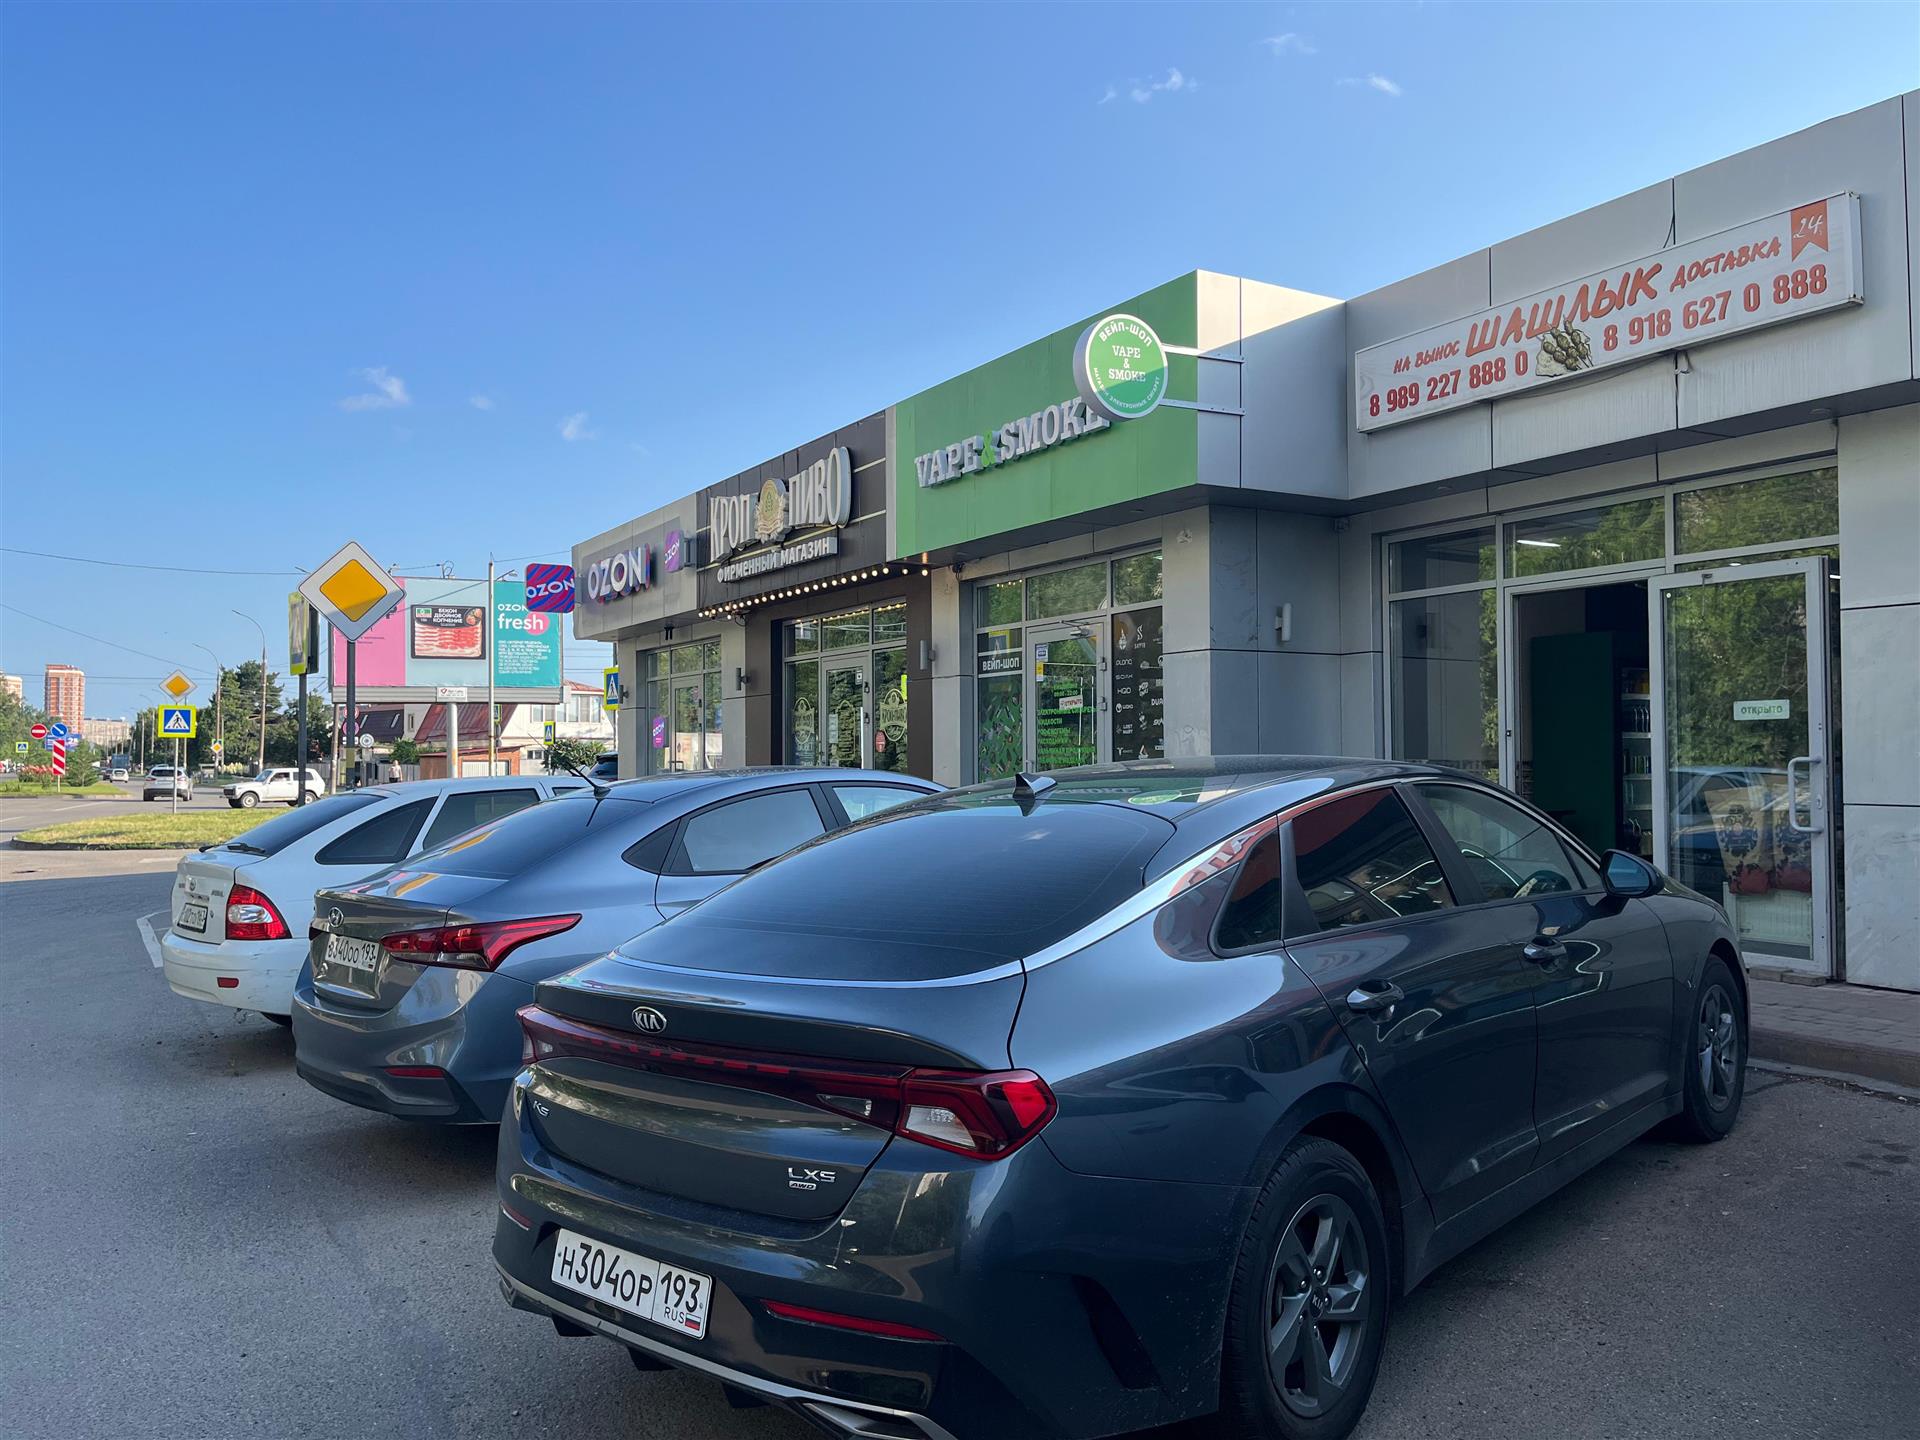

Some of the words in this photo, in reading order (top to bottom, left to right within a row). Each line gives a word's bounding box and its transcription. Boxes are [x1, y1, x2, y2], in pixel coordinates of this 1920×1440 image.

[1393, 360, 1411, 374] НА
[1415, 340, 1460, 368] ВЫНОС
[1465, 263, 1662, 357] ШАШЛЫК
[1669, 236, 1782, 292] ДОСТАВКА
[1604, 324, 1618, 351] 8
[1629, 309, 1671, 345] 918
[1683, 291, 1731, 329] 627
[1744, 283, 1760, 312] 0
[1773, 264, 1827, 304] 888
[1098, 320, 1153, 347] ВЕЙП-ШОП
[1112, 345, 1141, 359] VAPE
[1123, 358, 1130, 369] &
[1108, 368, 1146, 382] SMOKE
[1369, 394, 1380, 417] 8
[1387, 382, 1419, 412] 989
[1427, 369, 1461, 401] 227
[1469, 357, 1506, 389] 888
[1515, 351, 1529, 376] 0
[710, 493, 754, 564] КРОП
[788, 446, 851, 528] ПИВО
[717, 549, 777, 583] ФИРМЕННЫЙ
[780, 537, 836, 567] МАГАЗИН
[588, 544, 649, 601] OZON
[526, 578, 575, 598] OZON
[497, 612, 544, 630] fresh
[982, 657, 1020, 671] ВЕЙП-ШОП
[1741, 705, 1783, 716] открыто
[362, 943, 377, 961] 193
[635, 1011, 661, 1030] KIA
[791, 1182, 815, 1190] AWD
[560, 1242, 653, 1307] Н304ОР
[660, 1270, 701, 1313] 193
[663, 1306, 685, 1324] RUS
